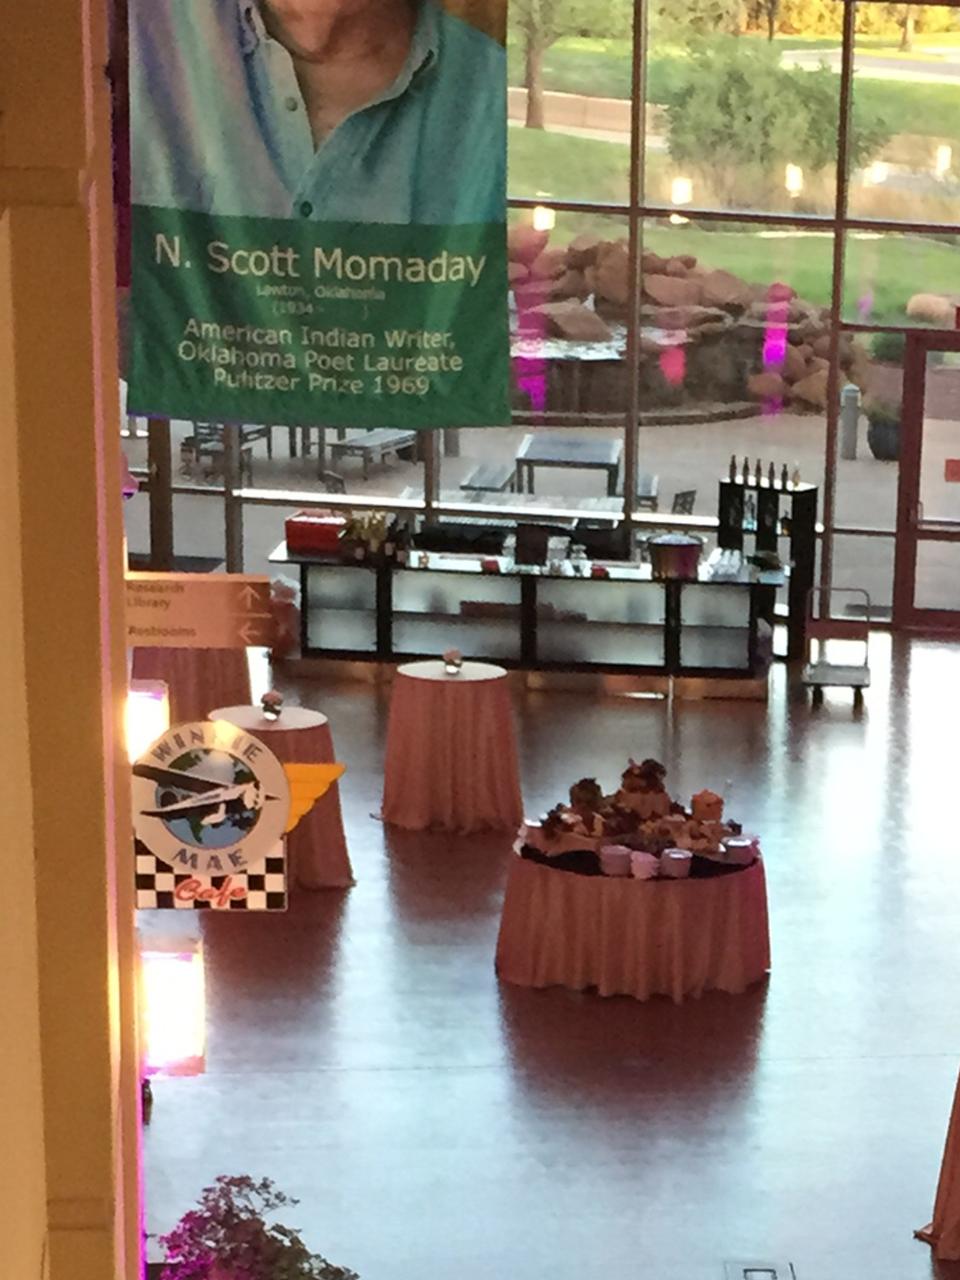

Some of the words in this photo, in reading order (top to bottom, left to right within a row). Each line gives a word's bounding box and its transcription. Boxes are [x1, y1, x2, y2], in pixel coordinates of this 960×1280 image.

[155, 233, 192, 268] N.
[206, 240, 301, 277] Scott
[313, 247, 487, 287] Momaday
[184, 317, 292, 346] American
[301, 326, 375, 348] Indian
[384, 330, 456, 350] Writer,
[178, 340, 297, 370] Oklahoma
[305, 350, 355, 373] Poet
[364, 353, 464, 373] Laureate
[214, 367, 300, 392] Pulitzer
[308, 373, 365, 395] Prize
[373, 375, 430, 396] 1969
[127, 597, 172, 612] Library
[171, 848, 248, 870] MAE
